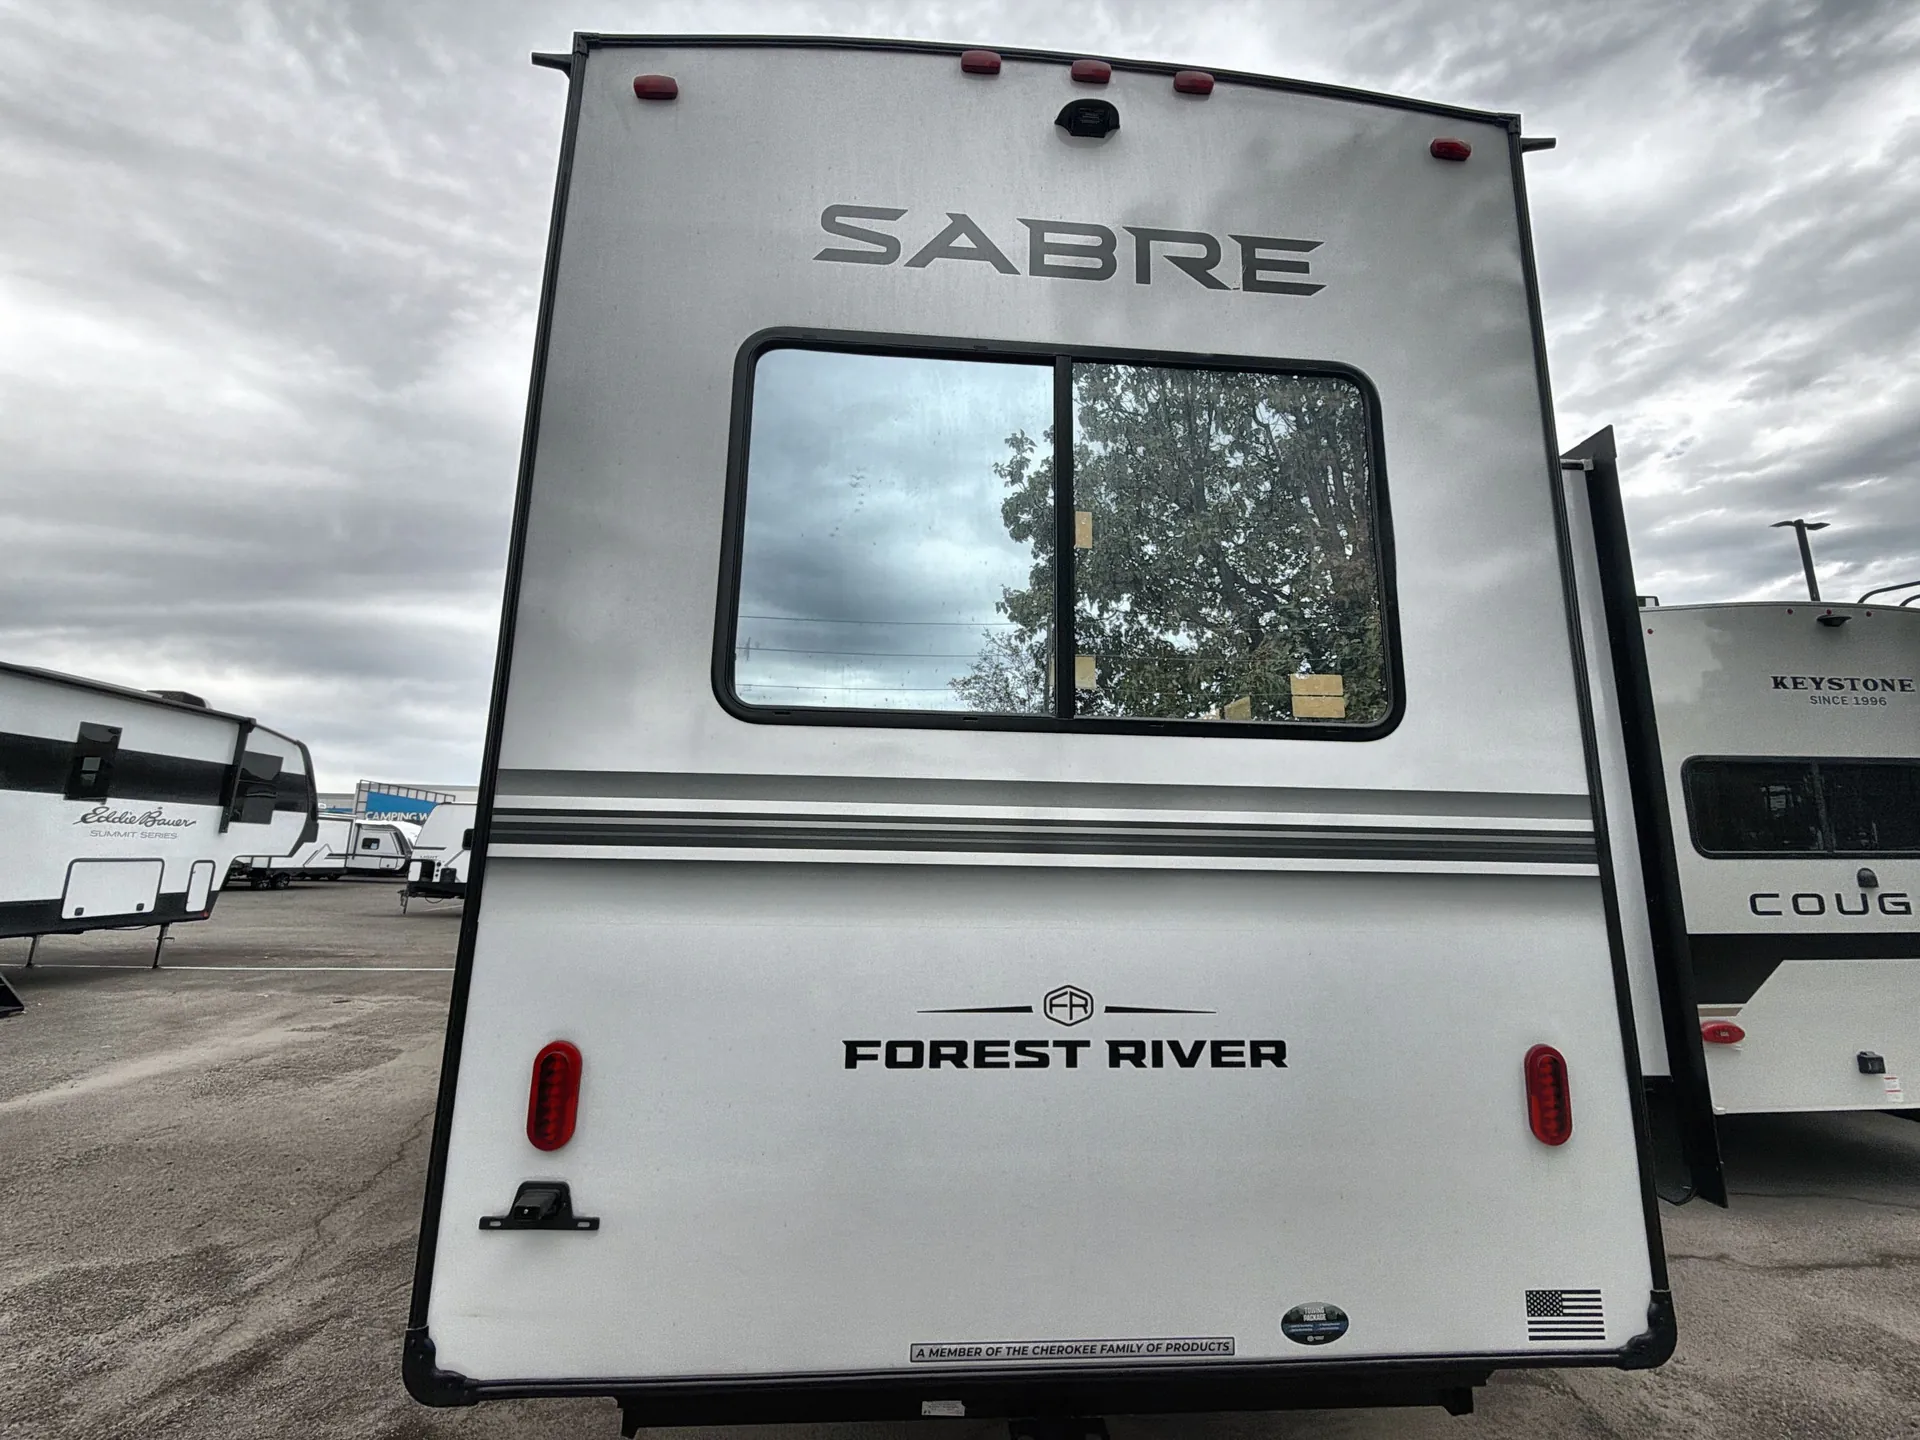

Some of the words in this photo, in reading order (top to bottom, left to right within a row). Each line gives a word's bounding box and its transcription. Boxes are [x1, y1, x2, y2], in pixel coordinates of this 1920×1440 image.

[812, 203, 1328, 297] SABRE
[1770, 676, 1915, 692] KEYSTONE
[1809, 695, 1849, 705] SINCE
[1852, 696, 1887, 706] 1996
[73, 806, 139, 825] Eddie
[138, 806, 196, 828] Bauer
[365, 811, 417, 821] CAMPING
[90, 830, 137, 839] SUMMIT
[139, 831, 178, 840] SERIES
[841, 1040, 1091, 1069] FOREST
[1104, 1040, 1289, 1069] RIVER
[915, 1349, 925, 1358] A
[928, 1347, 982, 1358] MEMBER
[985, 1346, 1002, 1357] OF
[1005, 1345, 1029, 1356] THE
[1031, 1344, 1097, 1355] CHEROKEE
[1100, 1343, 1144, 1354] FAMILY
[1146, 1342, 1163, 1353] OF
[1165, 1341, 1230, 1352] PRODUCTS
